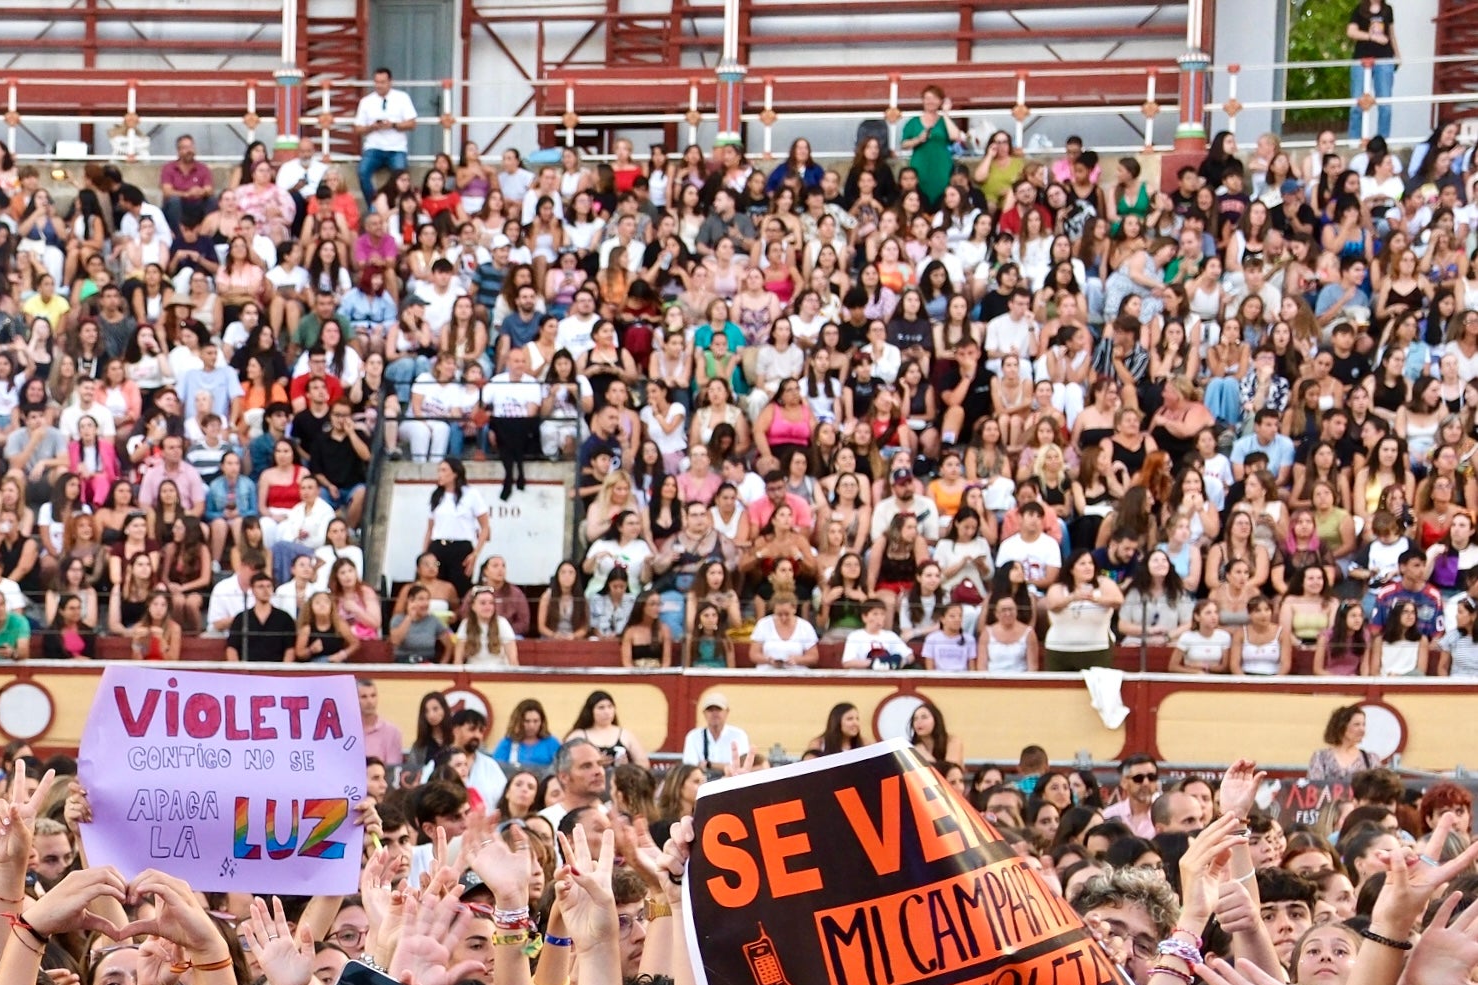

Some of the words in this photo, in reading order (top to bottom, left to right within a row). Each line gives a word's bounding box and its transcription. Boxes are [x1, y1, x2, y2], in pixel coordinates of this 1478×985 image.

[127, 743, 232, 771] CONTIGO
[243, 748, 275, 771] NO
[290, 750, 315, 772] SE
[126, 788, 219, 821] APAGA
[1295, 810, 1320, 825] FEST
[149, 825, 200, 859] LA
[233, 796, 350, 860] LUZ
[701, 799, 824, 908] SE
